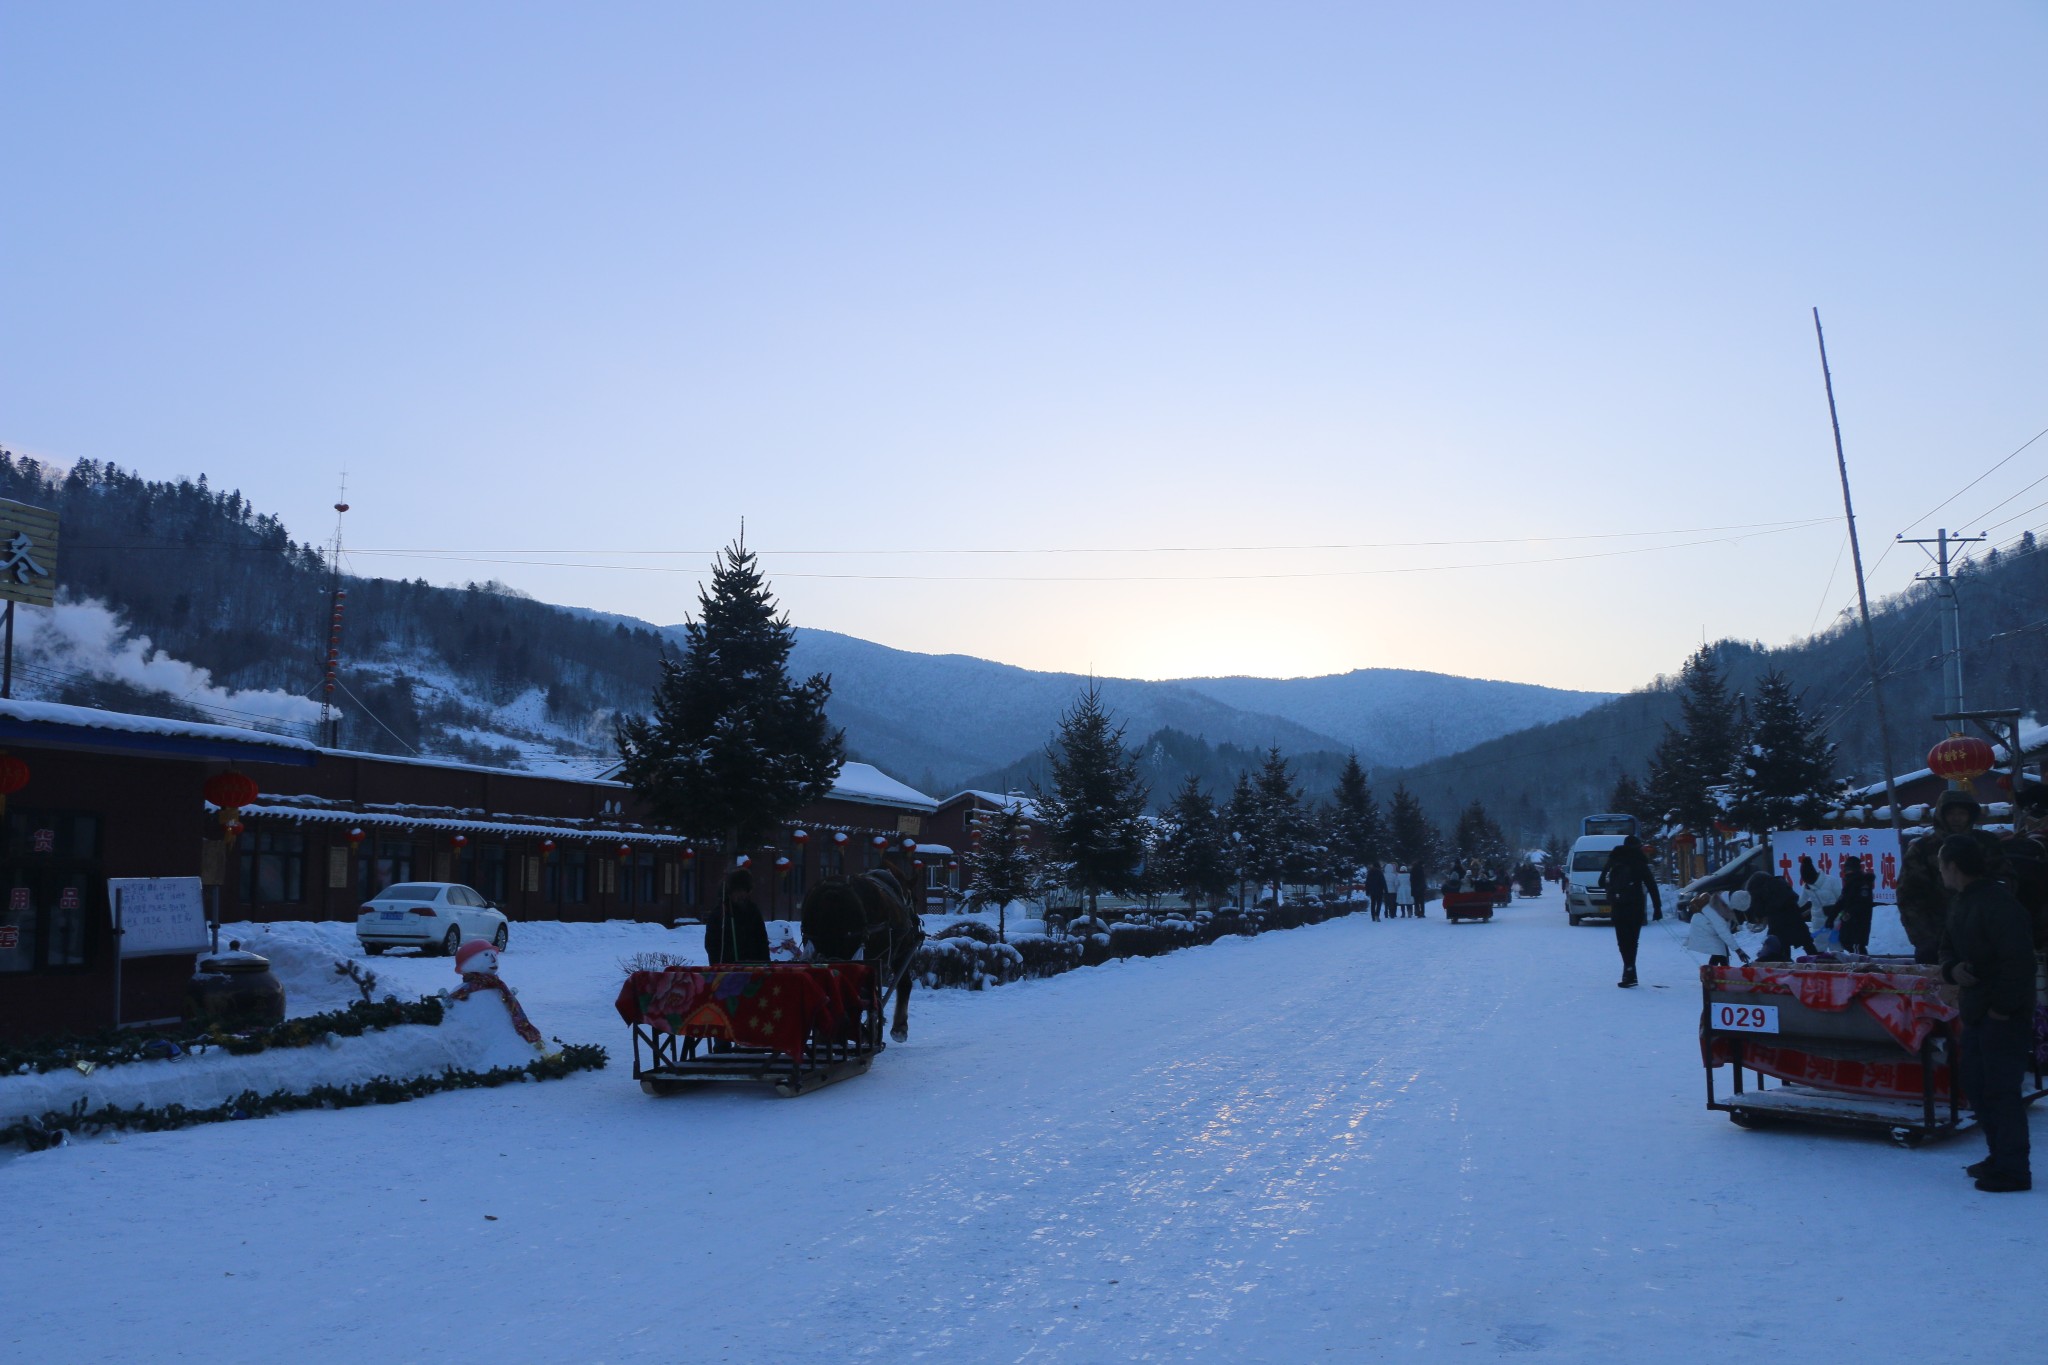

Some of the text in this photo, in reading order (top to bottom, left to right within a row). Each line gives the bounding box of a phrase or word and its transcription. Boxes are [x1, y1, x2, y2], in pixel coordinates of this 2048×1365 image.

[0, 532, 48, 585] 冬
[34, 829, 55, 852] 货
[1805, 834, 1870, 847] 中国雪谷
[1721, 1006, 1766, 1028] 029
